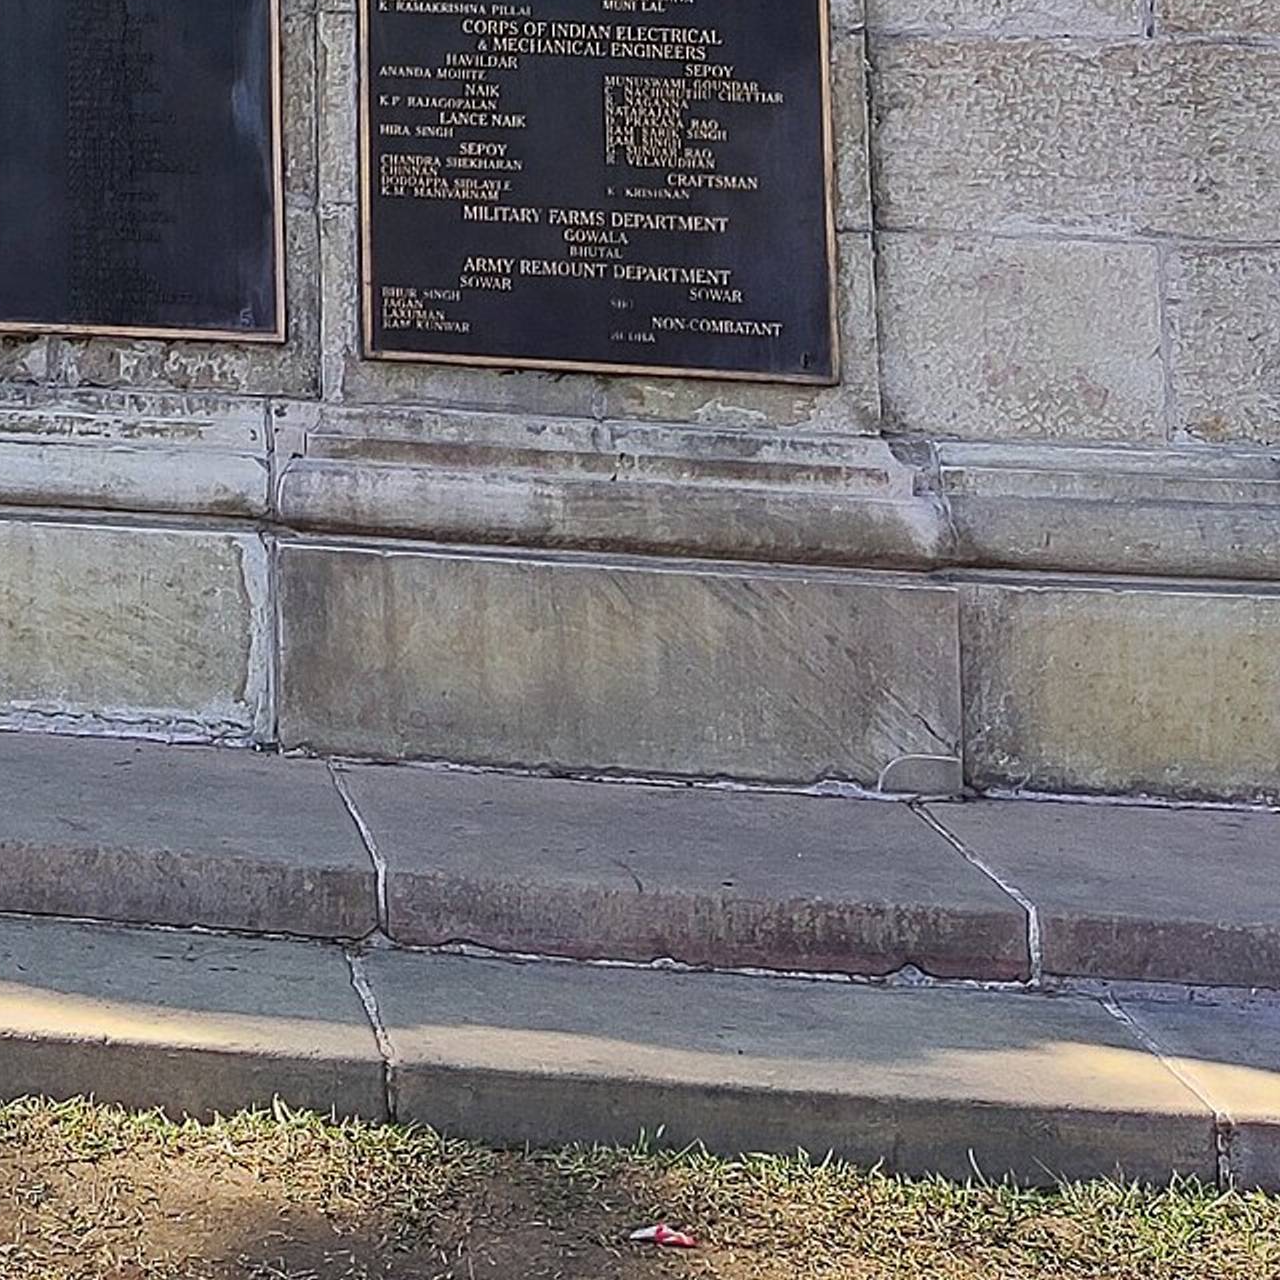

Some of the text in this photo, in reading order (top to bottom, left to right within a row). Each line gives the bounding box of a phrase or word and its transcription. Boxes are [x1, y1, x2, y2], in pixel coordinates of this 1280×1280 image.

[463, 20, 722, 45] CORPS OF INDIAN ELECTRICAL
[478, 37, 709, 60] & MECHANICAL ENGINEERS
[668, 174, 757, 189] CRAFTSMAN
[464, 205, 728, 233] MILITARY FARMS DEPARTMENT
[564, 229, 628, 244] GOWALA
[464, 258, 731, 285] ARMY REMOUNT DEPARTMENT
[650, 317, 782, 338] NON-COMBATANT
